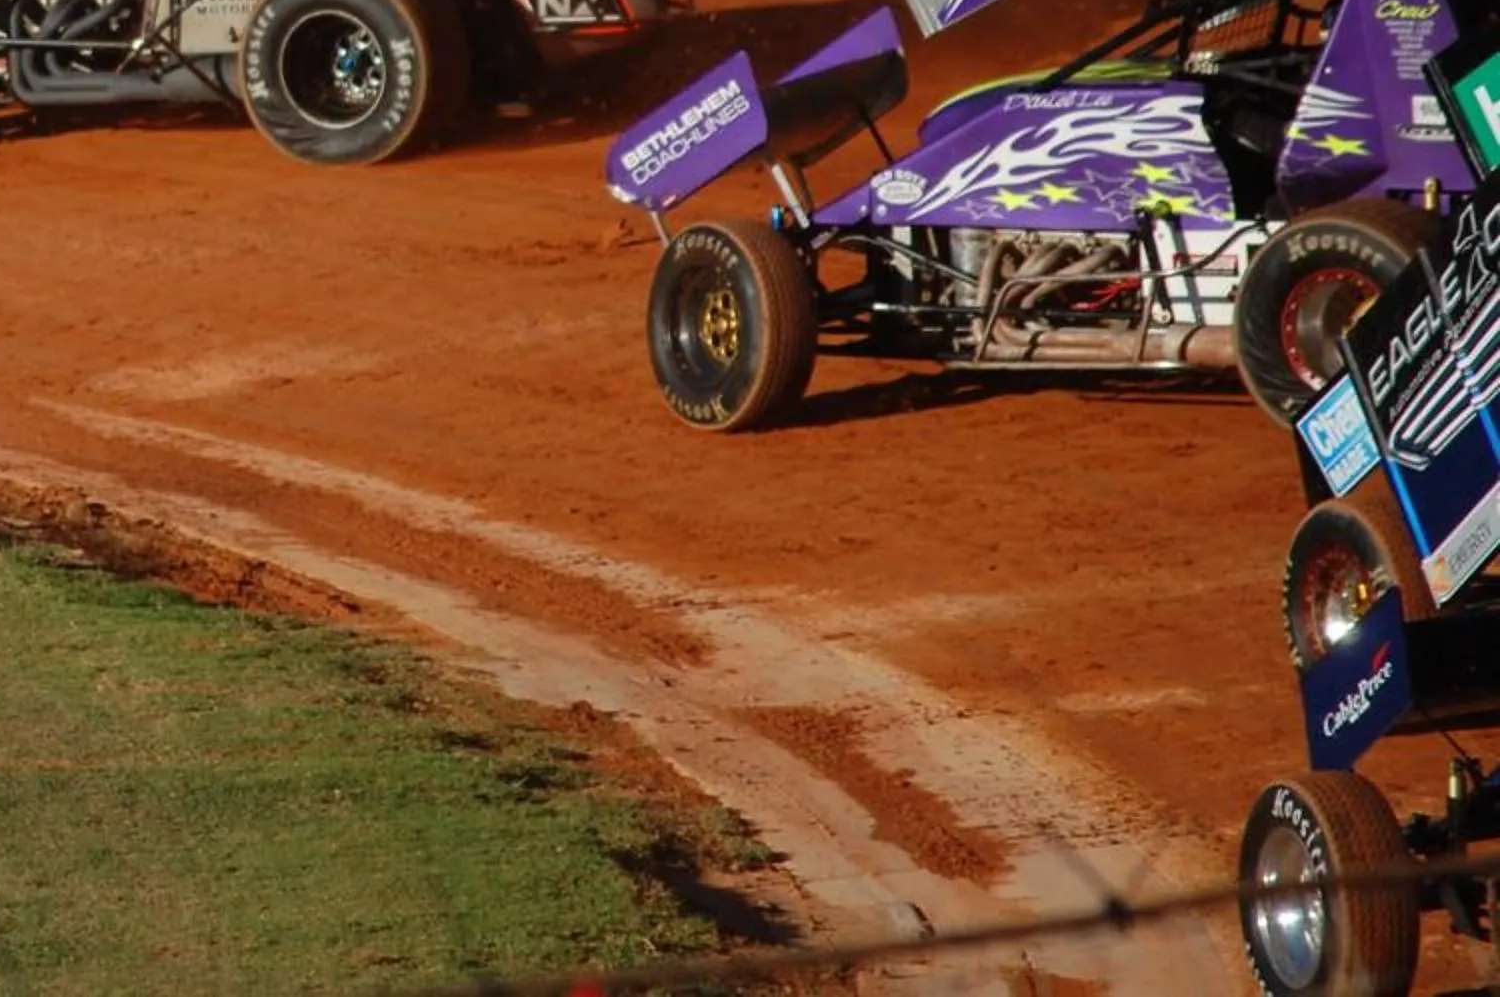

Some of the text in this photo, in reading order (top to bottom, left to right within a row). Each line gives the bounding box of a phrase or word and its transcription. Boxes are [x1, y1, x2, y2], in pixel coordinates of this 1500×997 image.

[619, 79, 742, 172] BETHLEHEM
[631, 93, 752, 186] COACHLINES
[1368, 259, 1462, 407] EAGLE
